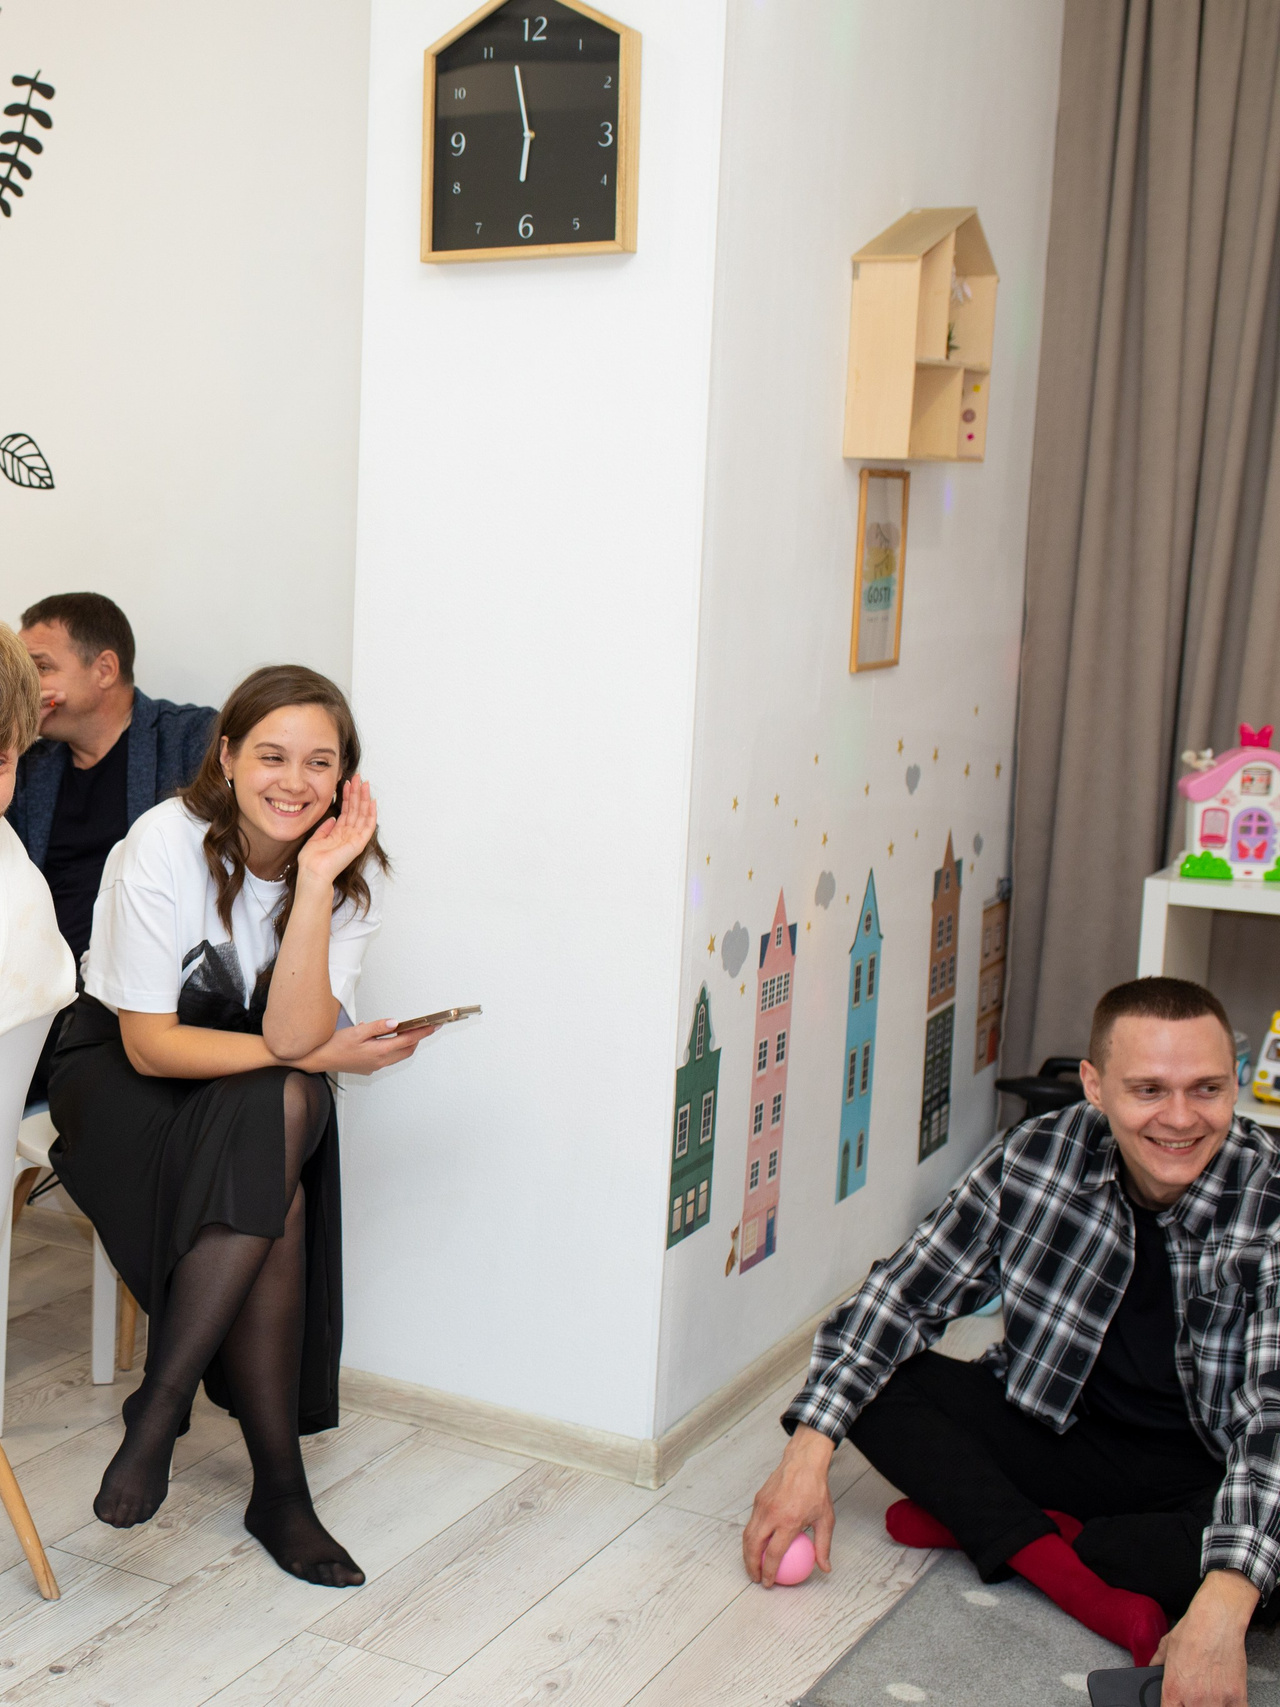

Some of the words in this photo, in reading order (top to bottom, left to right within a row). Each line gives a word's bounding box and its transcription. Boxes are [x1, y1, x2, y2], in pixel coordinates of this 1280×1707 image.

[523, 16, 548, 42] 12
[578, 38, 584, 51] 1
[483, 46, 494, 59] 11
[603, 75, 612, 89] 2
[454, 87, 467, 100] 10
[598, 121, 614, 148] 3
[450, 131, 466, 157] 9
[600, 174, 608, 186] 4
[452, 181, 461, 194] 8
[475, 222, 483, 235] 7
[518, 213, 534, 239] 6
[572, 217, 581, 230] 5
